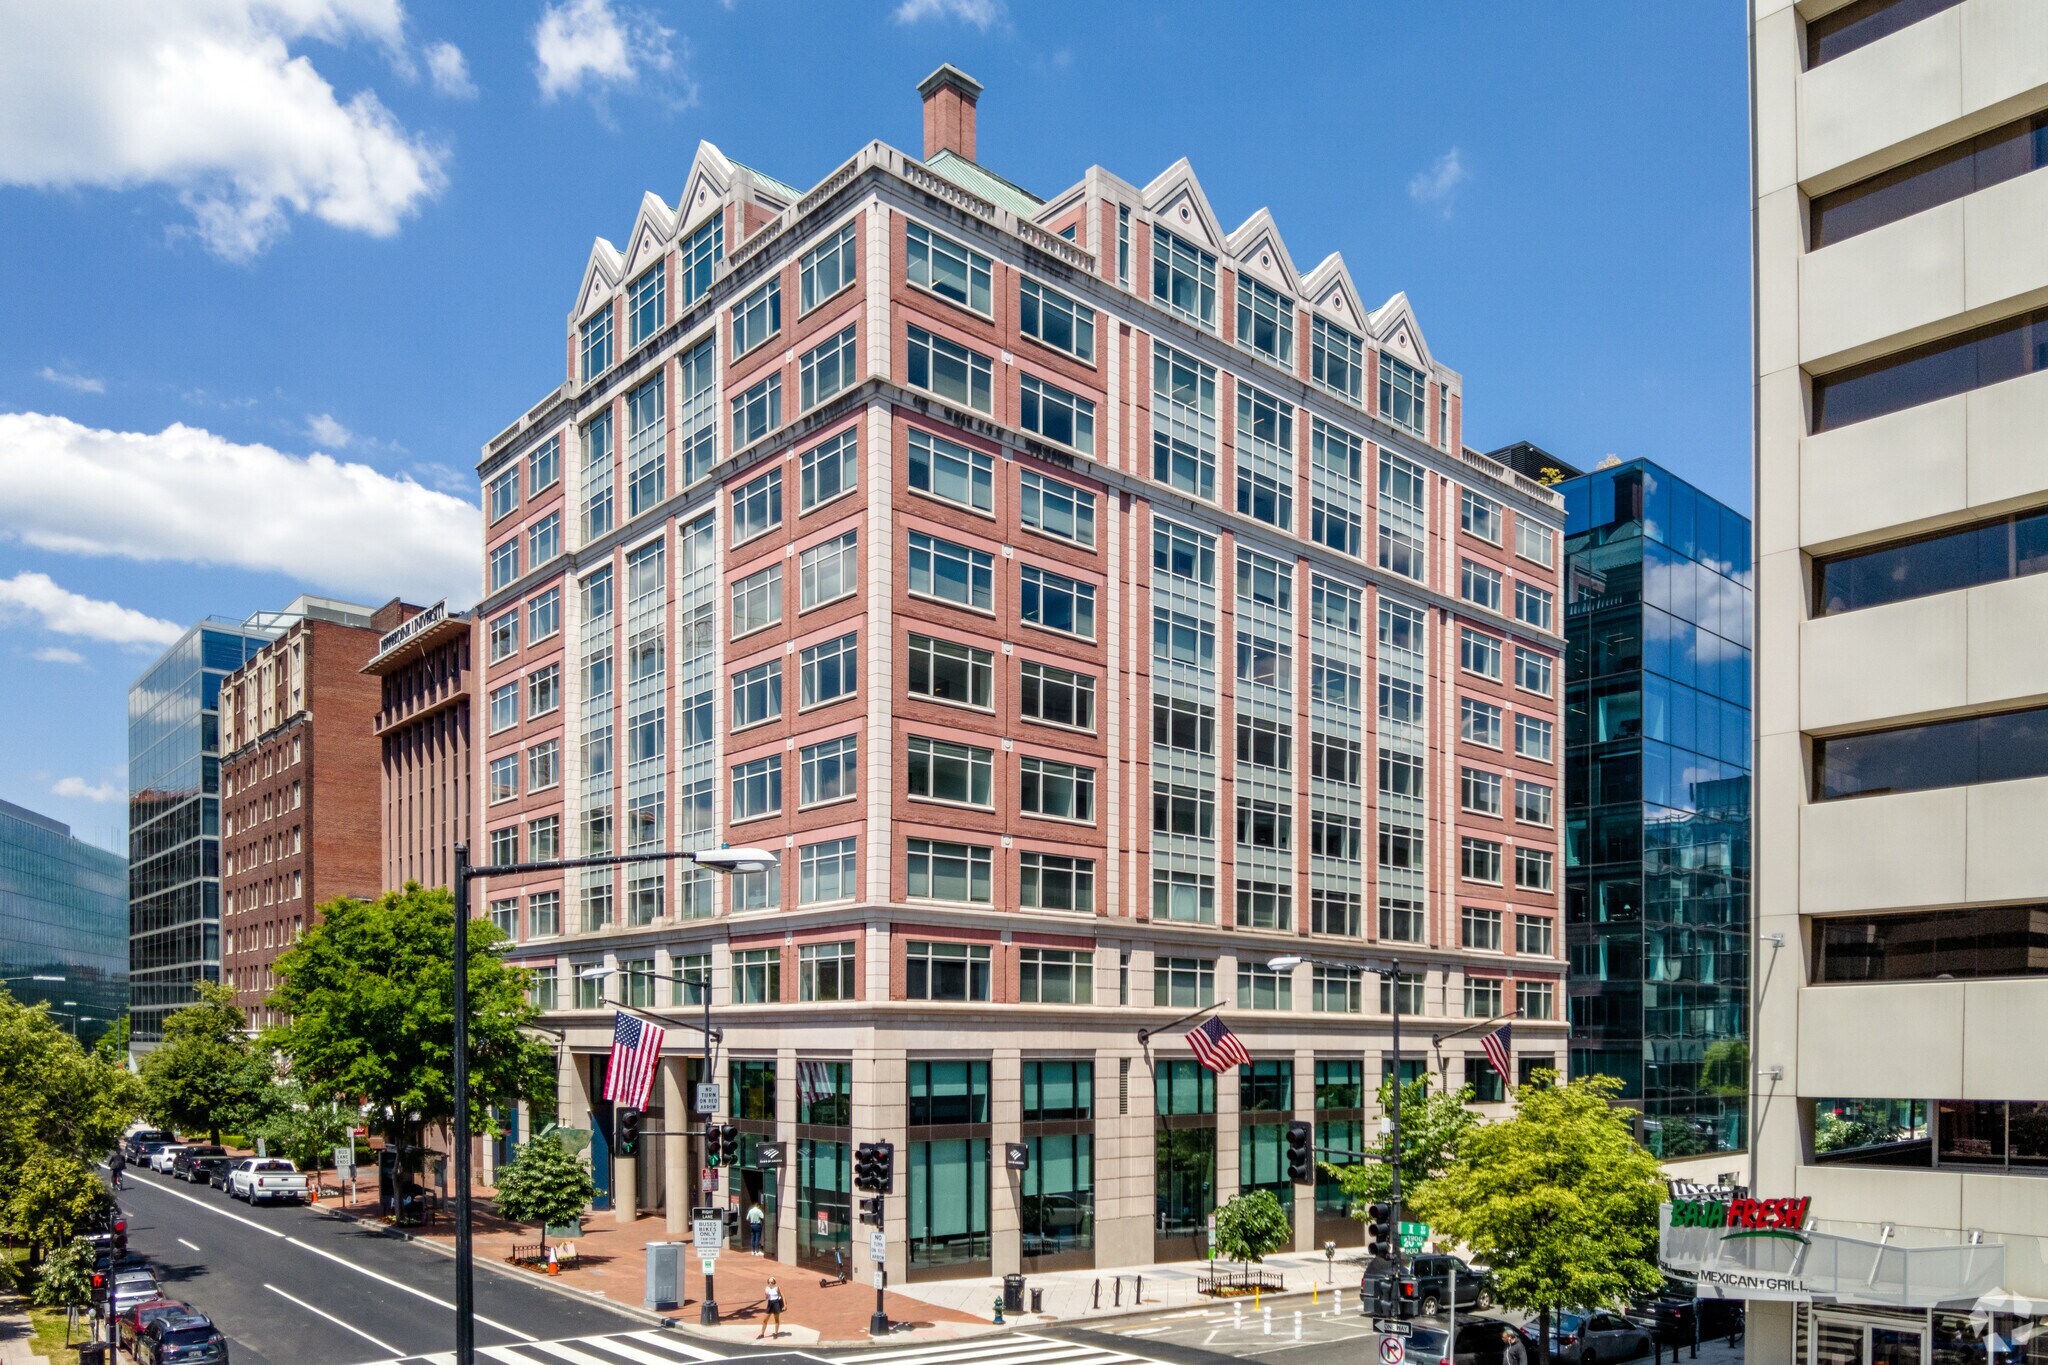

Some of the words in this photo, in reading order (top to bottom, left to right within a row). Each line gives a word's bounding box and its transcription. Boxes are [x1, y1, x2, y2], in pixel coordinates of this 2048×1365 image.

[1670, 1200, 1723, 1229] BAJA
[1728, 1196, 1808, 1231] FRESH
[1700, 1270, 1758, 1287] MEXICAN
[1767, 1279, 1809, 1291] GRILL
[1384, 1323, 1396, 1331] ONE
